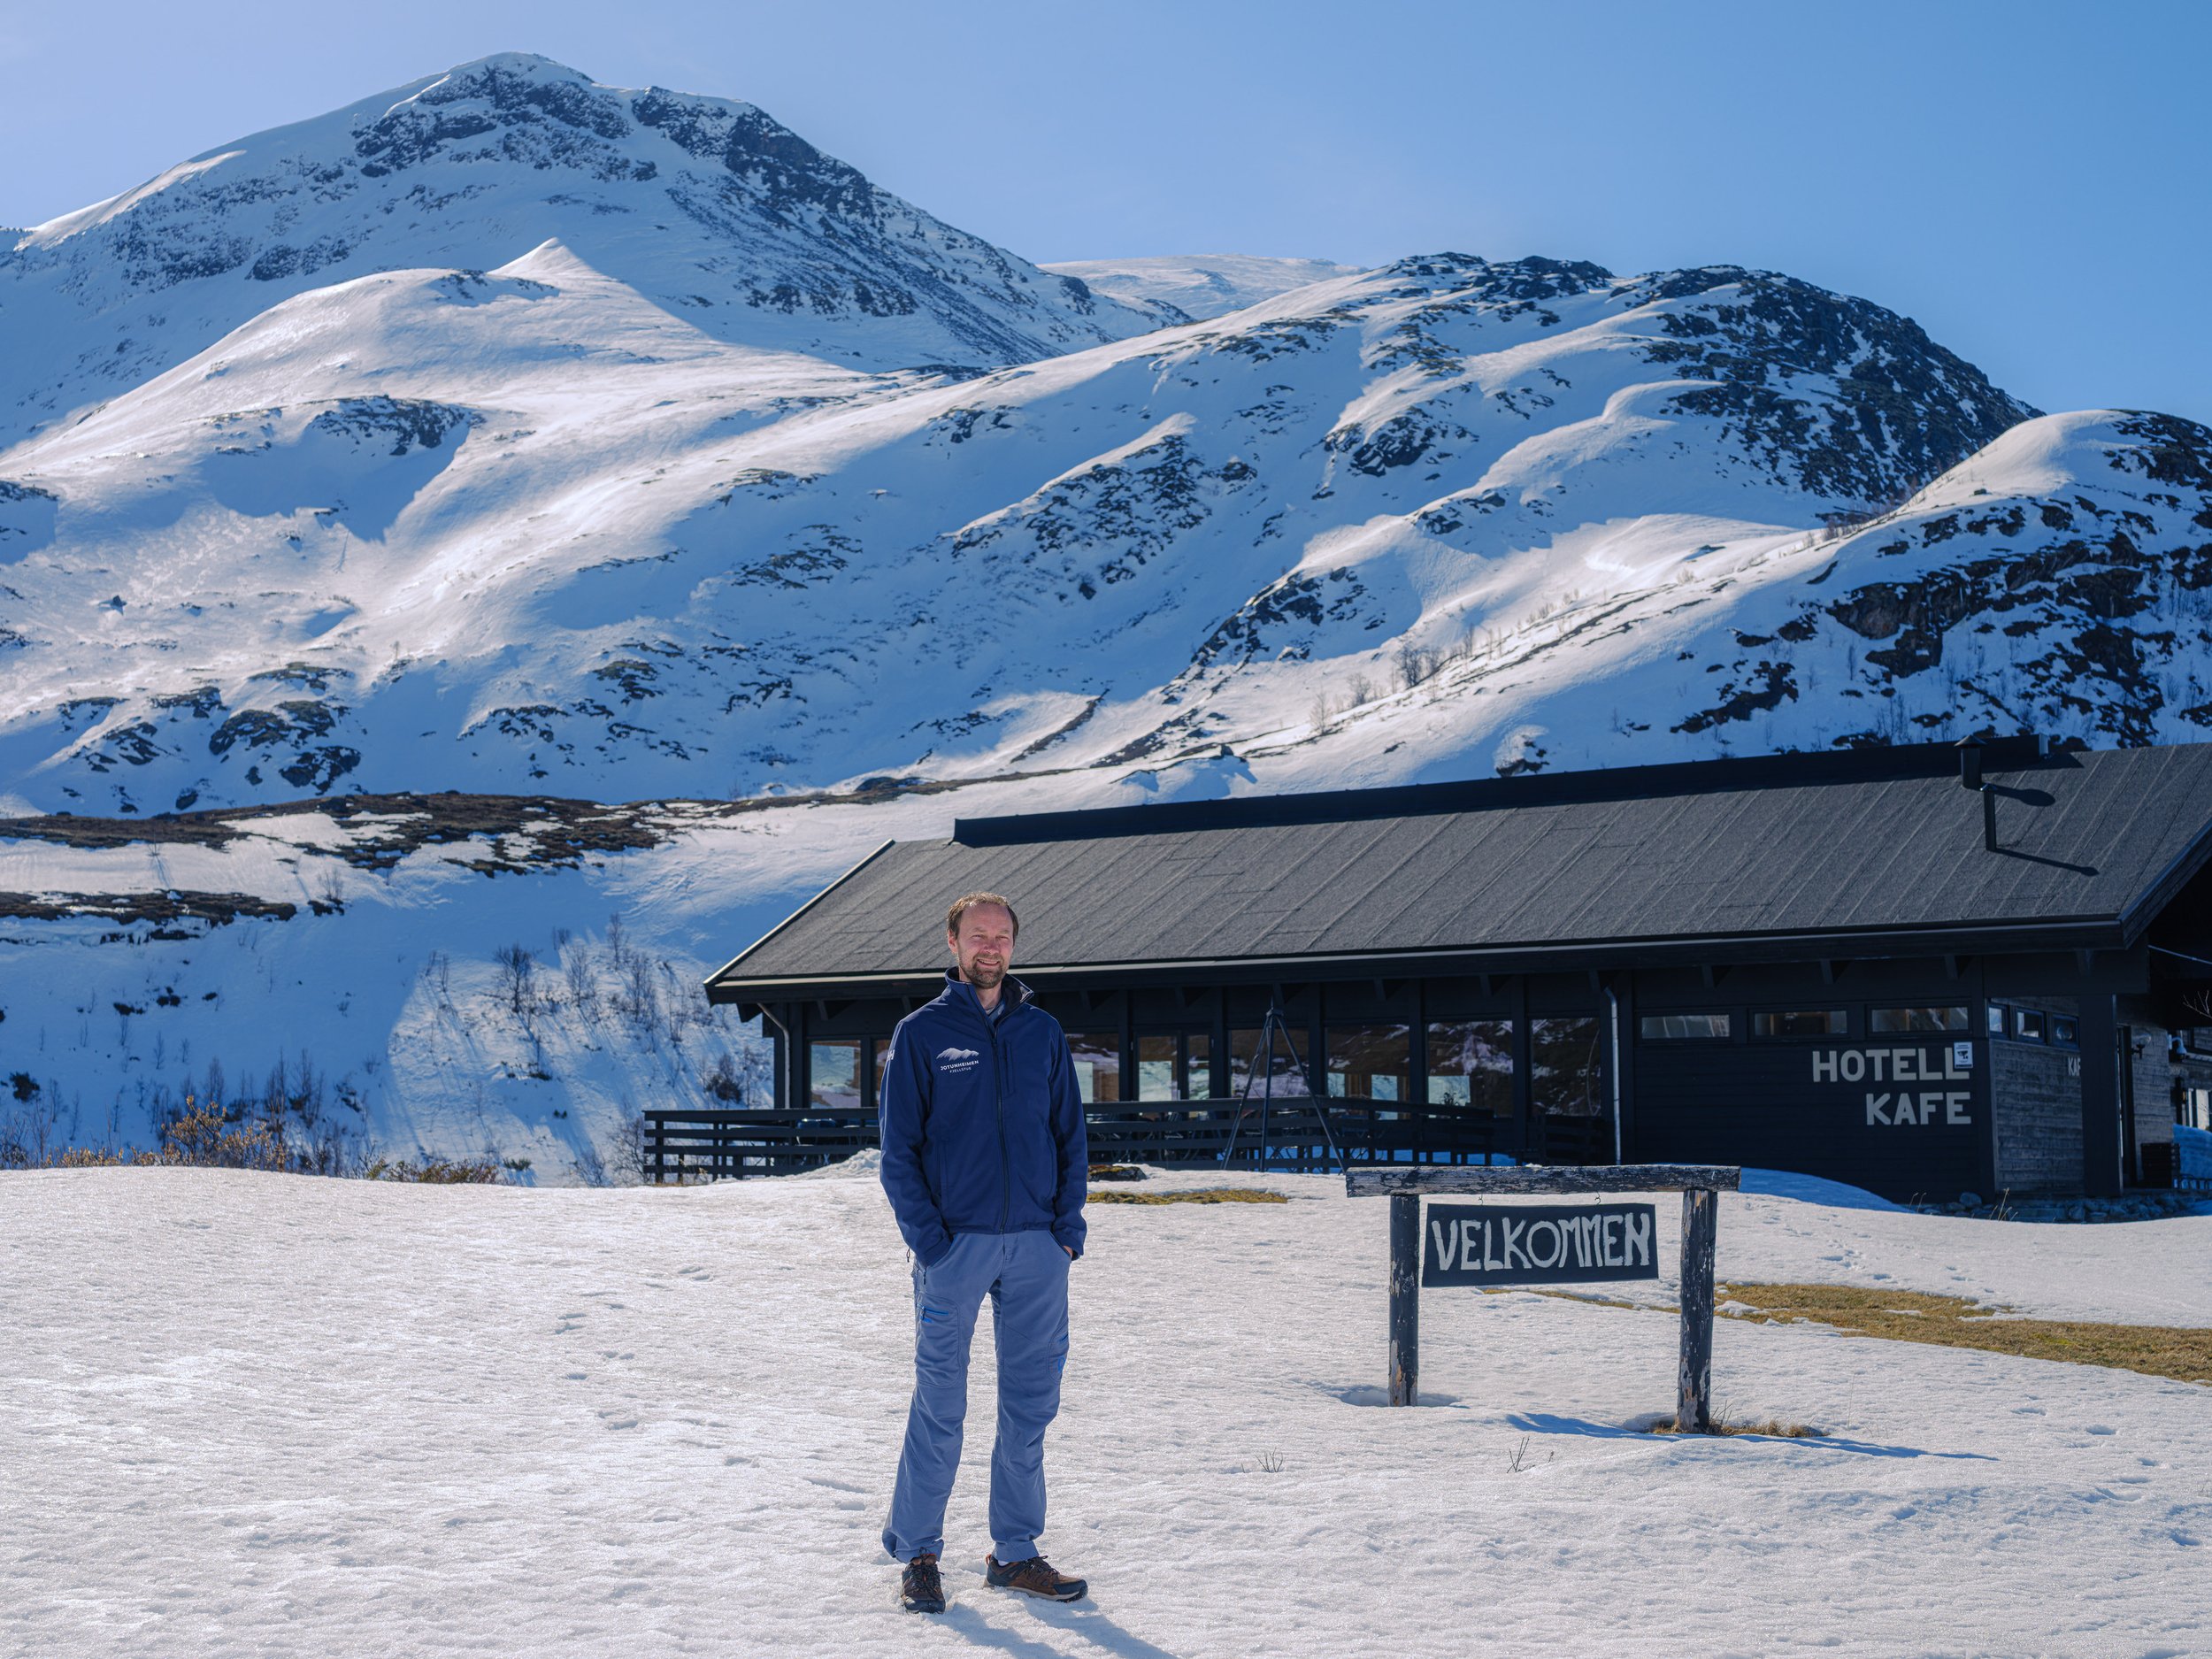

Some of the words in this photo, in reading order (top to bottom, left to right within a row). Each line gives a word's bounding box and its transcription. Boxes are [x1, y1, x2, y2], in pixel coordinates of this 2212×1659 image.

[941, 1060, 979, 1071] JOTUNHEIMEN
[1812, 1048, 1970, 1083] HOTELL
[1866, 1092, 1971, 1125] KAFE
[1431, 1212, 1651, 1271] VELKOMMEN
